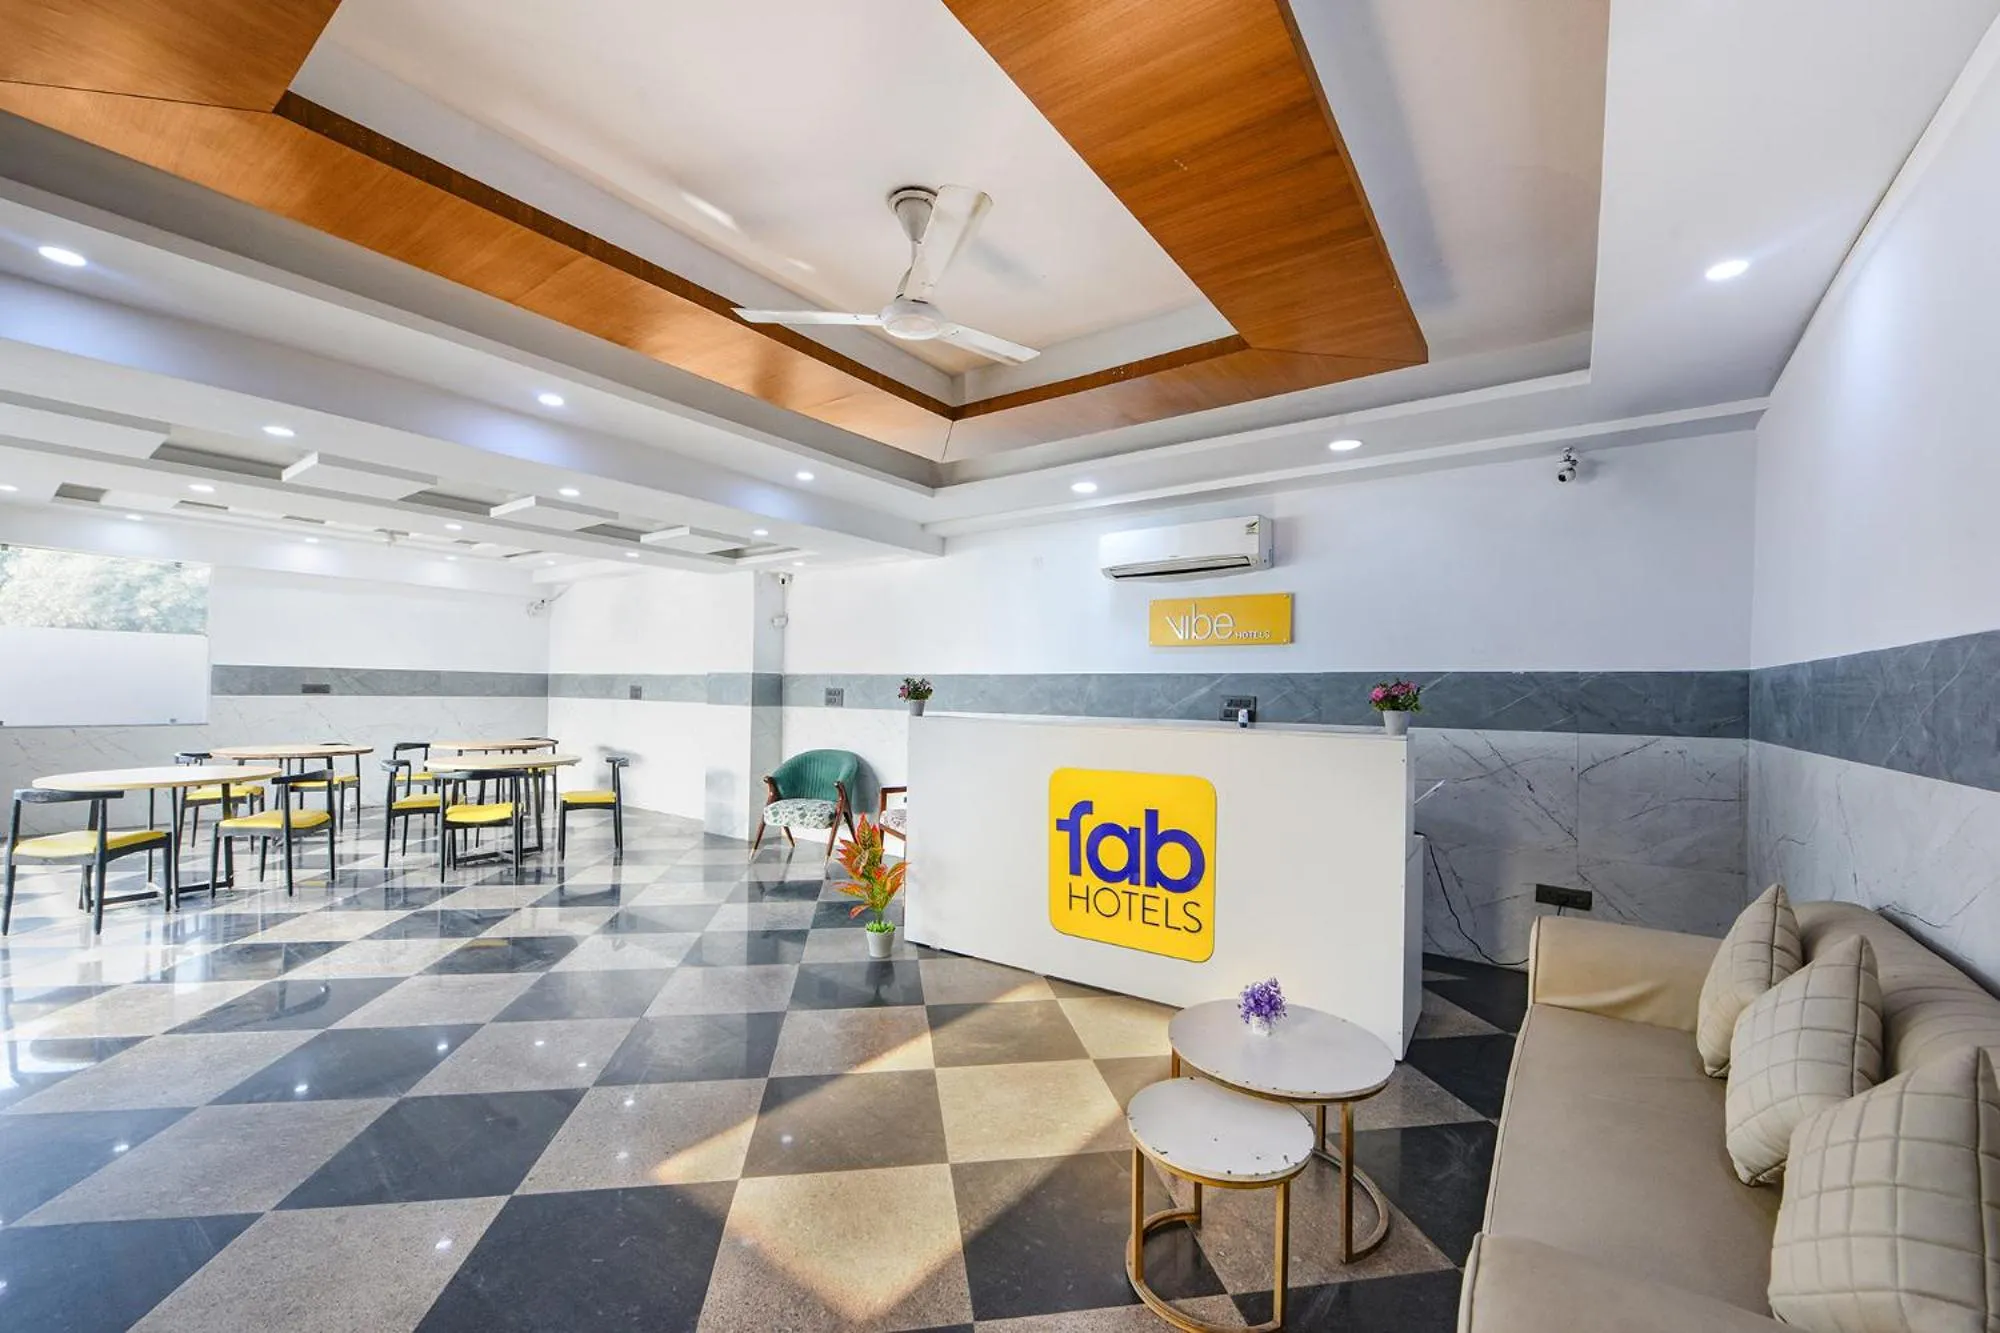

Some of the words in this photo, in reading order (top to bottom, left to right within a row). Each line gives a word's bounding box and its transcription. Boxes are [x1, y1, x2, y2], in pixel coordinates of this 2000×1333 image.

[1165, 600, 1234, 640] vibe
[1236, 629, 1272, 640] HOTELS
[1056, 800, 1205, 893] fab
[1068, 882, 1203, 933] HOTELS
